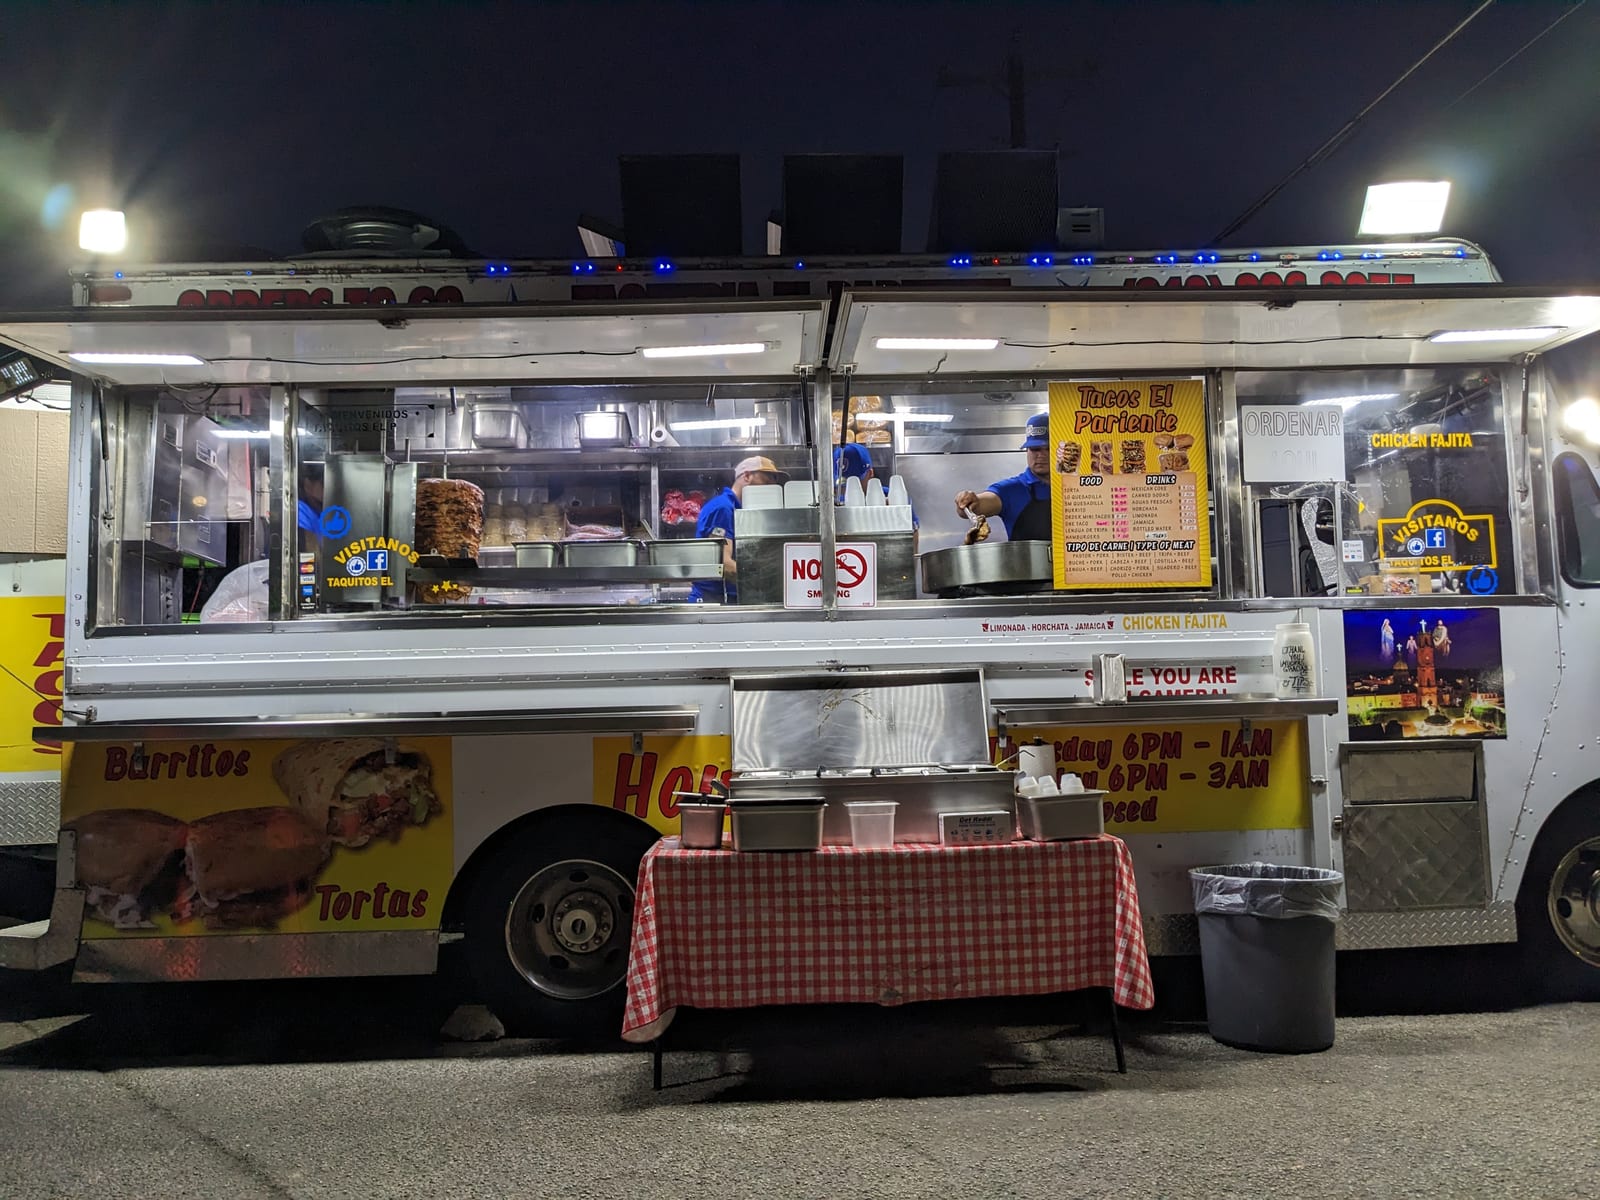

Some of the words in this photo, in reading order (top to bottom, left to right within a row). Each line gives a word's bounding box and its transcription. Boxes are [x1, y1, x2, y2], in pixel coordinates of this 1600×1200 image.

[1077, 385, 1141, 409] Tacos
[1149, 384, 1174, 408] El
[1074, 409, 1178, 434] Pariente
[1244, 411, 1341, 437] ORDENAR
[1371, 433, 1428, 448] CHICKEN
[1430, 433, 1473, 448] FAJITA
[1080, 476, 1103, 486] FOOD
[1146, 475, 1176, 485] DRINKS
[1392, 514, 1479, 543] VISITANOS
[333, 536, 420, 565] VISITANOS
[1066, 542, 1087, 552] TIPO
[1088, 542, 1101, 551] DE
[1101, 541, 1130, 551] CARNE
[1136, 541, 1158, 550] TYPE
[1159, 540, 1171, 550] OF
[1172, 540, 1196, 550] MEAT
[792, 559, 823, 580] NO
[1441, 555, 1454, 565] EL
[327, 577, 378, 588] TAQUITOS
[381, 577, 393, 587] EL
[807, 590, 850, 598] SMNG
[990, 623, 1026, 632] LIMONADA
[1031, 622, 1069, 631] HORCHATA
[1075, 622, 1106, 630] JAMAICA
[1122, 615, 1181, 631] CHICKEN
[1184, 613, 1228, 629] FAJITA
[1150, 667, 1195, 686] YOU
[1198, 666, 1237, 684] ARE
[1123, 731, 1182, 760] 6PM
[1221, 728, 1273, 758] 1AM
[104, 744, 250, 781] Burritos
[1108, 762, 1168, 792] 6PM
[1208, 760, 1269, 789] 3AM
[316, 882, 429, 921] Tortas
